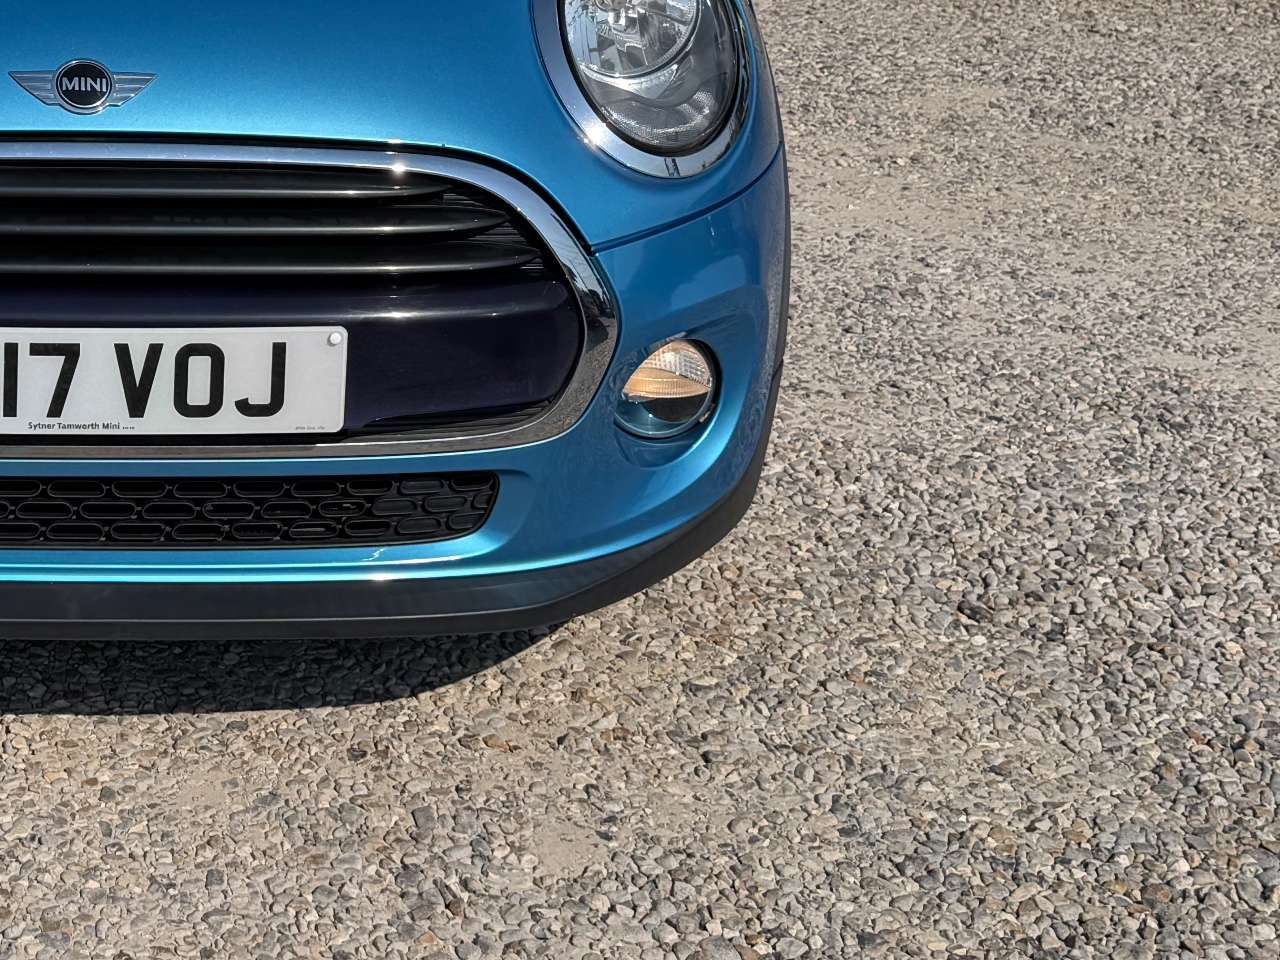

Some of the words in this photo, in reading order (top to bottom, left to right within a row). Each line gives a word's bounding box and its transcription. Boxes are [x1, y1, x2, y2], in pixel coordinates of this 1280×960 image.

[61, 76, 107, 92] MINI
[113, 341, 287, 419] VOJ
[28, 421, 56, 433] Sytner
[57, 421, 100, 430] Tamworth
[102, 422, 121, 430] Mini
